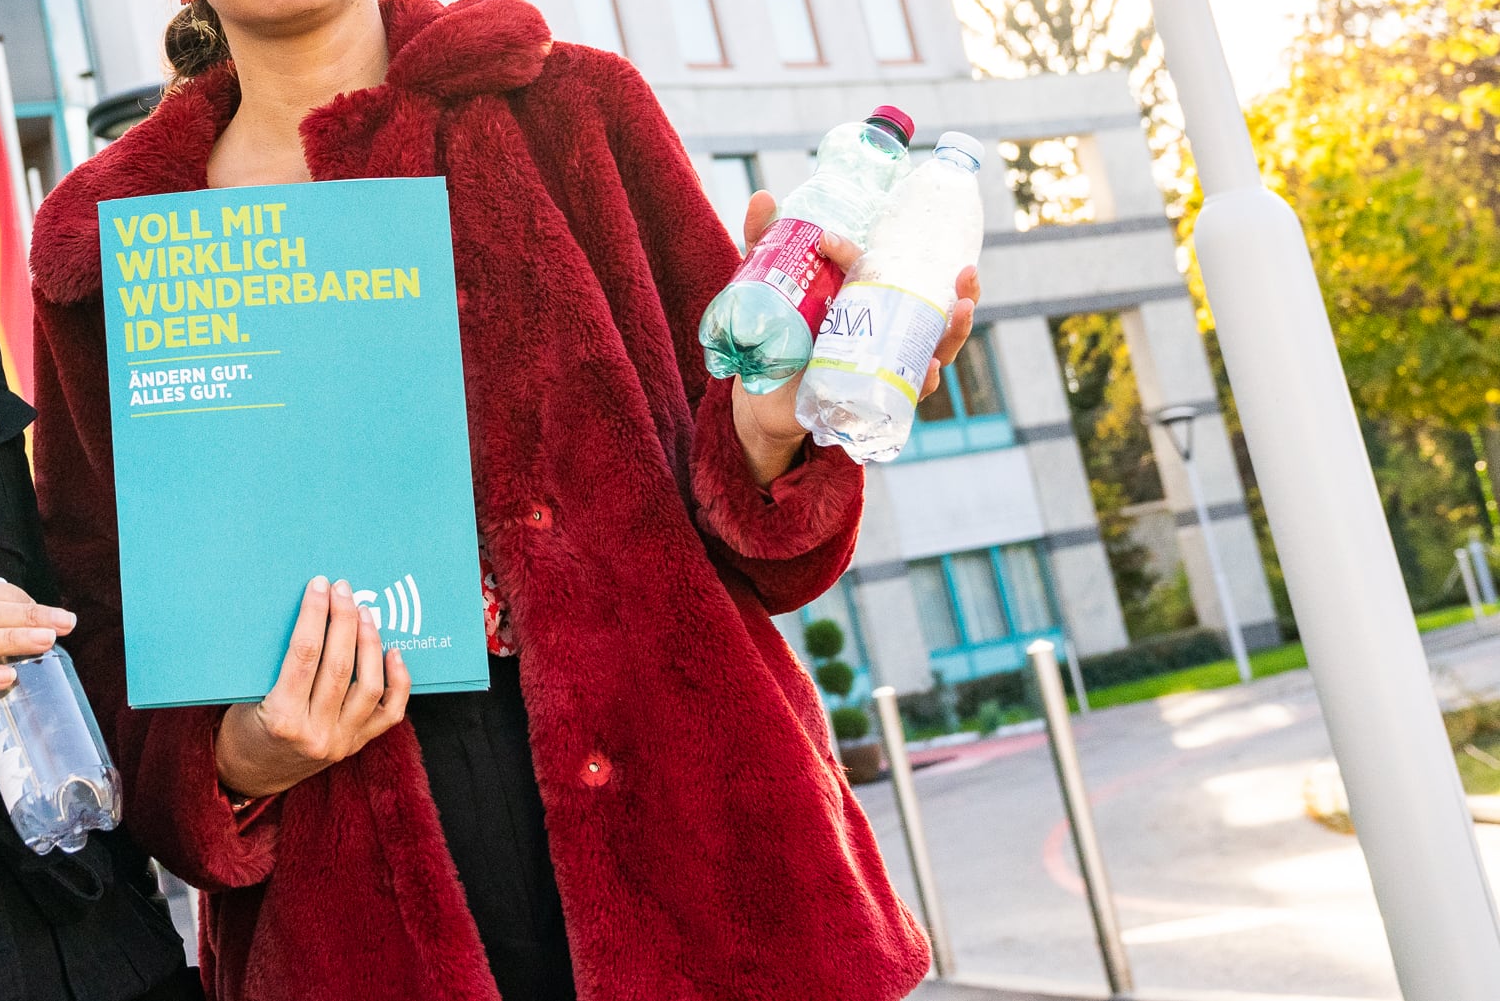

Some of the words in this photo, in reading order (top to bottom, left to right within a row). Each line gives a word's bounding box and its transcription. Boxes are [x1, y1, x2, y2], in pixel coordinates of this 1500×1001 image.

[113, 210, 212, 247] VOLL
[221, 203, 287, 237] MIT
[116, 237, 307, 282] WIRKLICH
[118, 267, 421, 317] WUNDERBAREN
[124, 312, 251, 353] IDEEN.
[818, 307, 872, 336] SILVA
[128, 367, 206, 389] ÄNDERN
[211, 364, 253, 381] GUT.
[130, 387, 186, 407] ALLES
[190, 383, 232, 400] GUT.
